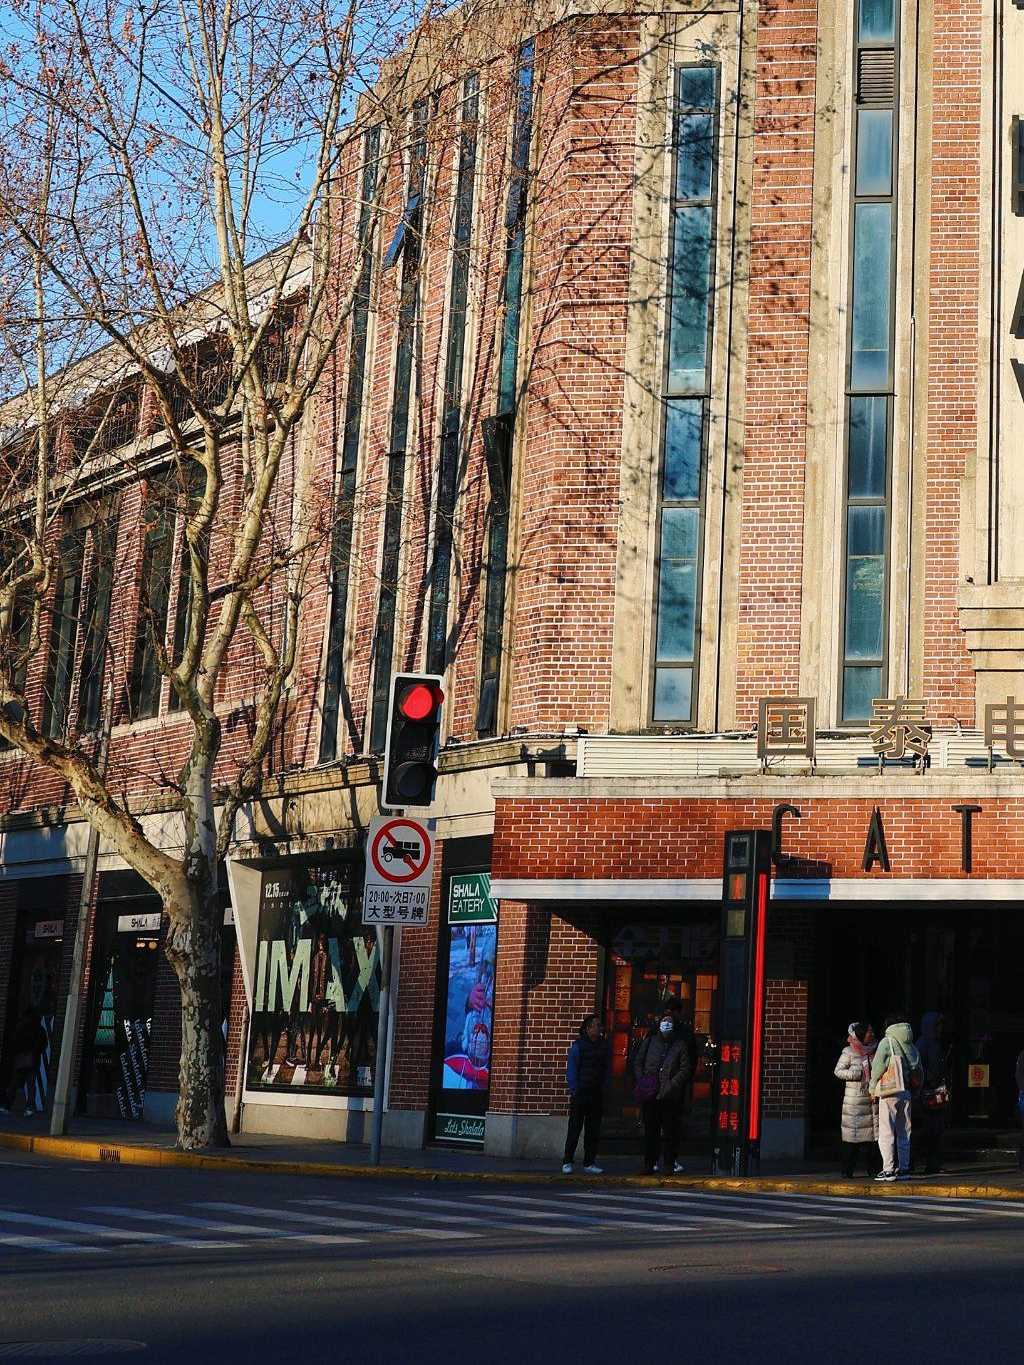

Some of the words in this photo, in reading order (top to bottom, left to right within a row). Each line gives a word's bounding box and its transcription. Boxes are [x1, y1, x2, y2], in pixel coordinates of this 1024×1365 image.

[369, 890, 426, 904] 20:00-次日7:00
[453, 883, 480, 898] SHALA
[368, 905, 424, 920] 大型号牌
[452, 898, 486, 913] EATERY
[255, 935, 381, 1013] IMAX
[718, 1110, 739, 1131] 信号
